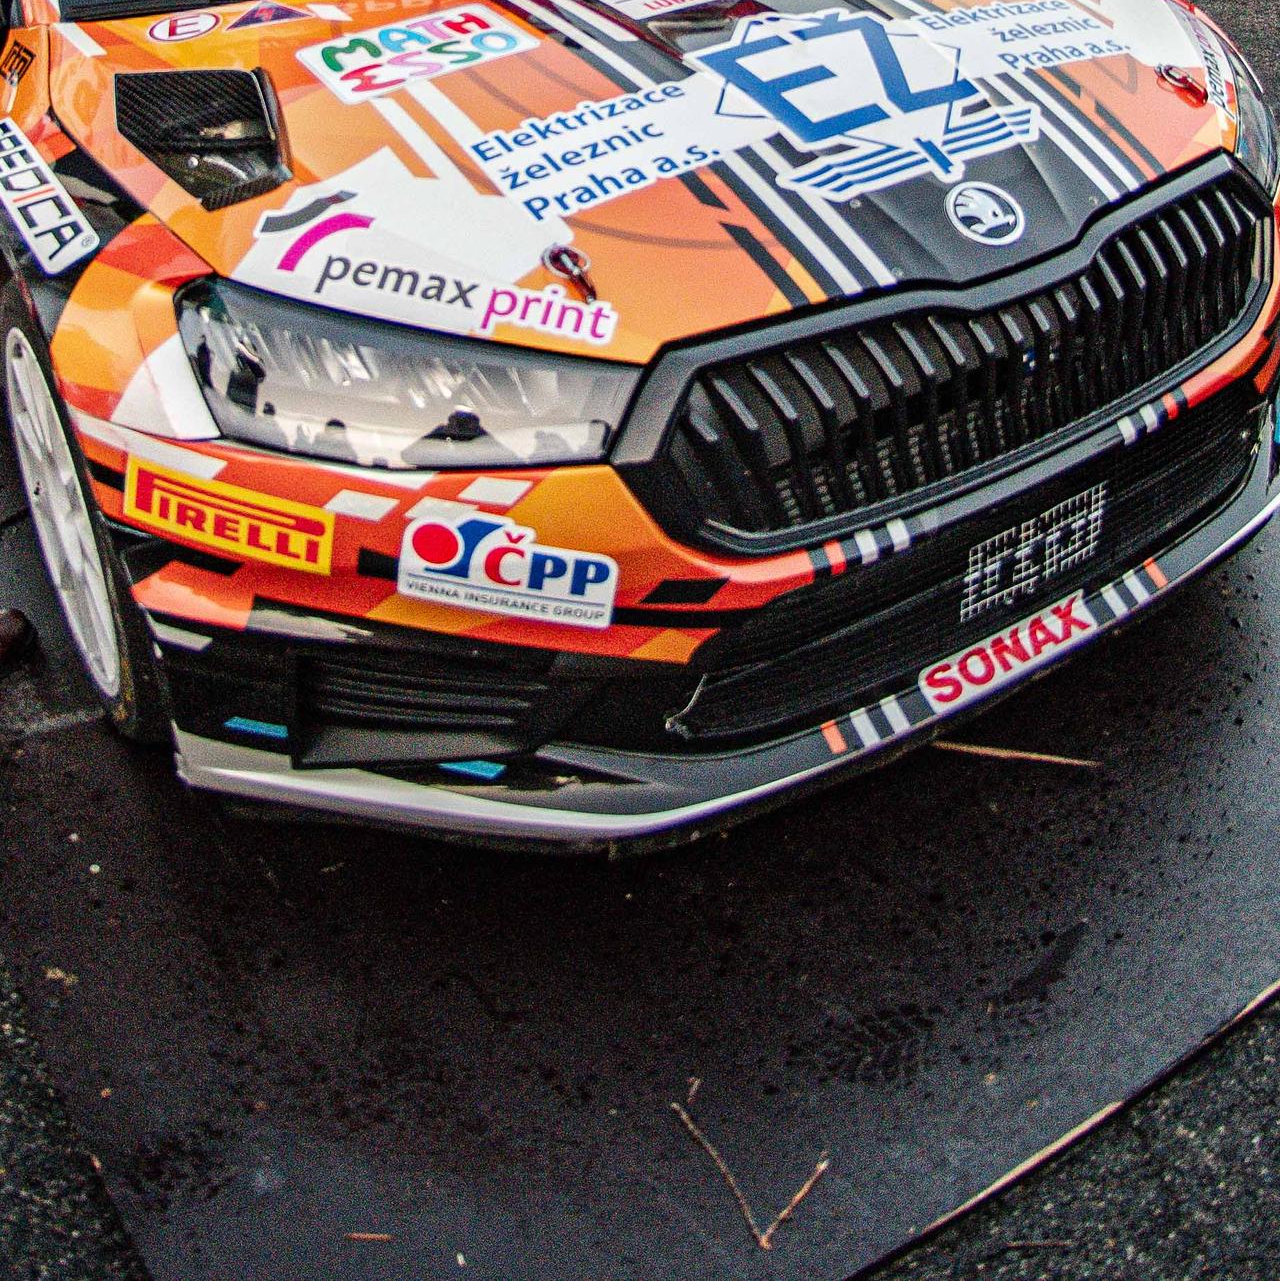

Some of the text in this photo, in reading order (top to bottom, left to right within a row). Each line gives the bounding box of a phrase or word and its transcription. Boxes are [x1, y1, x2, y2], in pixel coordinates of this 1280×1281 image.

[320, 11, 492, 73] MATH
[338, 29, 518, 94] ESSO
[986, 16, 1102, 43] železnic
[997, 38, 1131, 70] Praha a.s.
[470, 83, 686, 162] Elektrizace
[498, 122, 665, 190] železnic
[522, 143, 721, 222] Praha a.s.
[314, 253, 612, 339] pemax print
[134, 467, 327, 565] PIRELLI
[483, 530, 611, 596] ČPP
[406, 580, 606, 621] VIENNA INSURANCE GROUP
[922, 593, 1095, 704] SONAX
